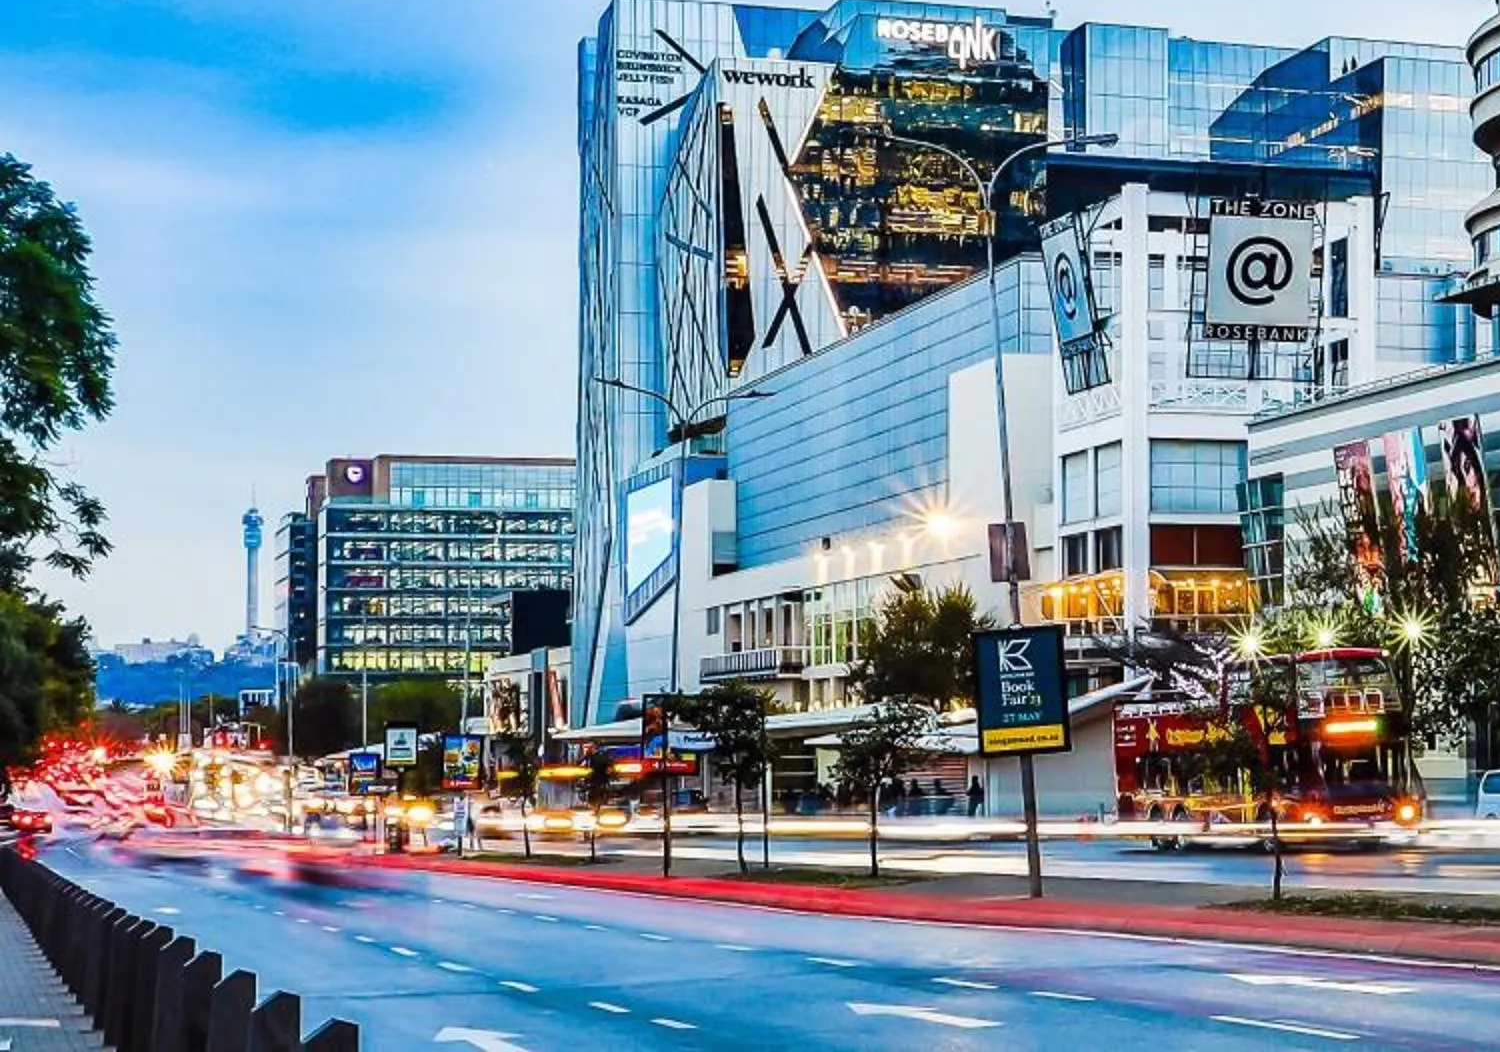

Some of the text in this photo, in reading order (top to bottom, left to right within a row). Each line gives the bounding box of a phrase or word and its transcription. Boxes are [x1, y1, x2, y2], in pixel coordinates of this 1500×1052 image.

[721, 67, 815, 89] wework
[1212, 200, 1315, 219] THE ZONE
[1204, 324, 1308, 341] ROSEBANK
[1001, 679, 1035, 694] Book
